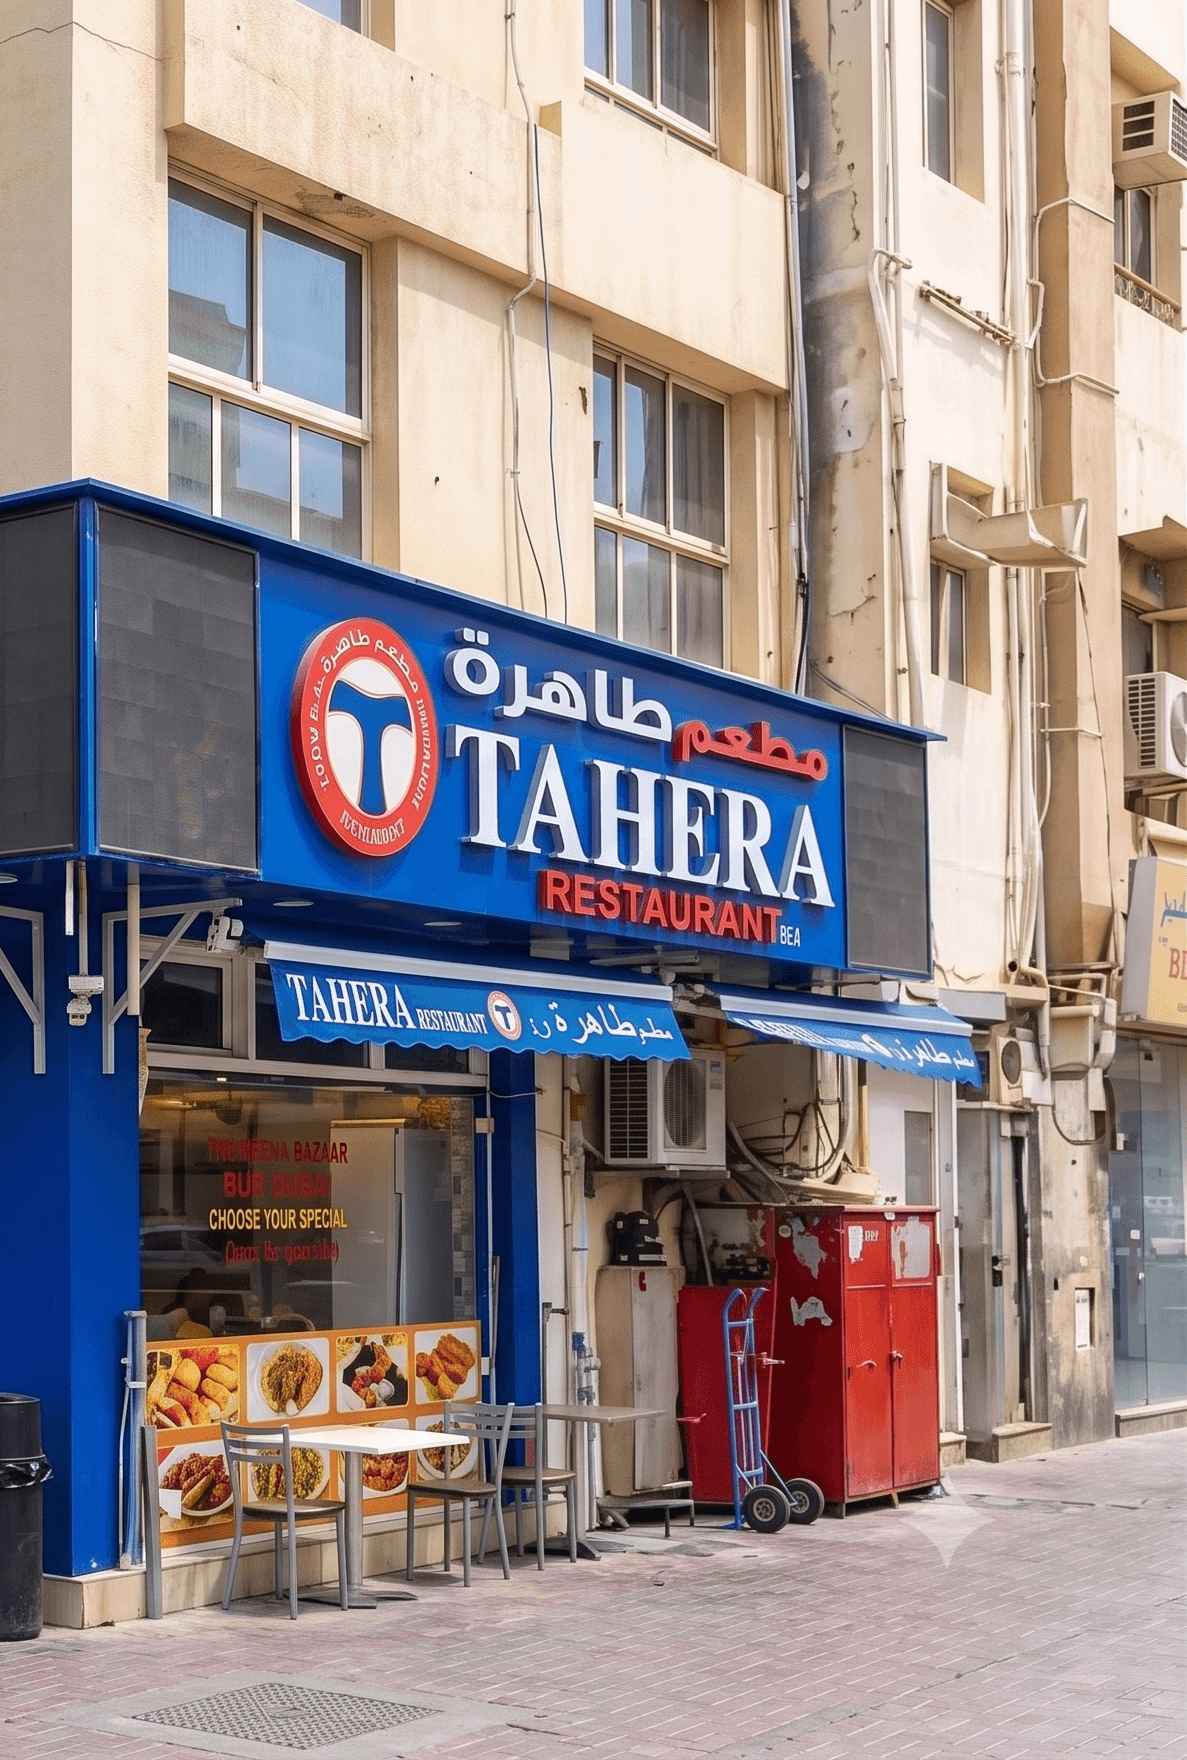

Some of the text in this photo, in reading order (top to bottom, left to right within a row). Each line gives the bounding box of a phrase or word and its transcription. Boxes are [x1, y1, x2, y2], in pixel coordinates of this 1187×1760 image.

[444, 627, 829, 782] مطعم طاهرة
[445, 724, 836, 909] TAHERA
[537, 869, 801, 948] RESTAURANT BEA
[285, 972, 417, 1030] TAHERA
[416, 1008, 489, 1035] RESTAURANT
[548, 1001, 638, 1044] طاهرة
[294, 1141, 348, 1164] BAZAAR
[223, 1171, 266, 1198] BUR
[209, 1208, 348, 1230] CHOOSE YOUR SPECIAL
